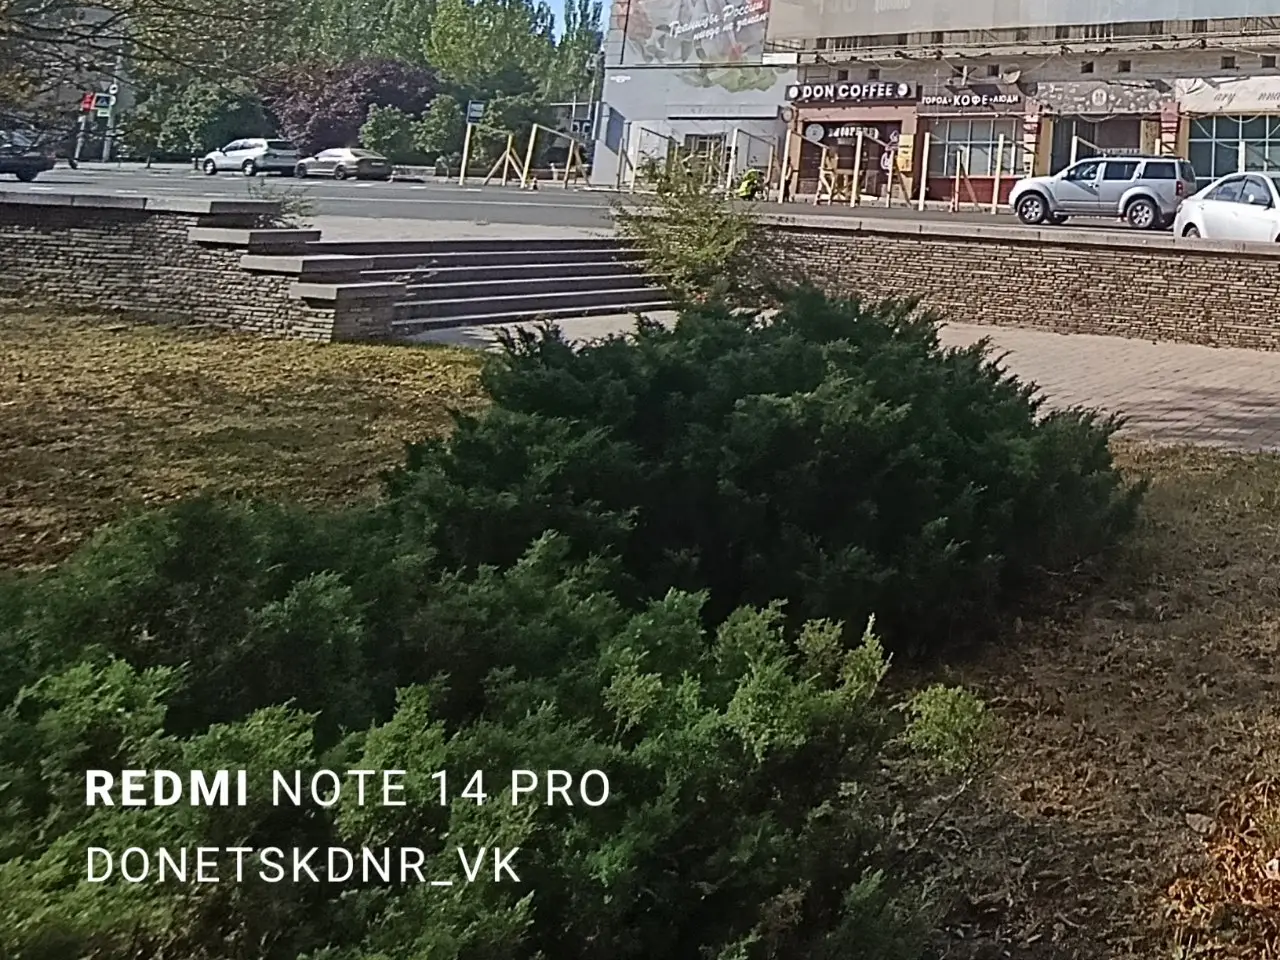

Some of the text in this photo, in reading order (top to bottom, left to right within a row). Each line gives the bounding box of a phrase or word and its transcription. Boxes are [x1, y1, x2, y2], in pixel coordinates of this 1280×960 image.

[803, 84, 892, 98] DON COFFEE
[953, 94, 988, 106] КОФЕ
